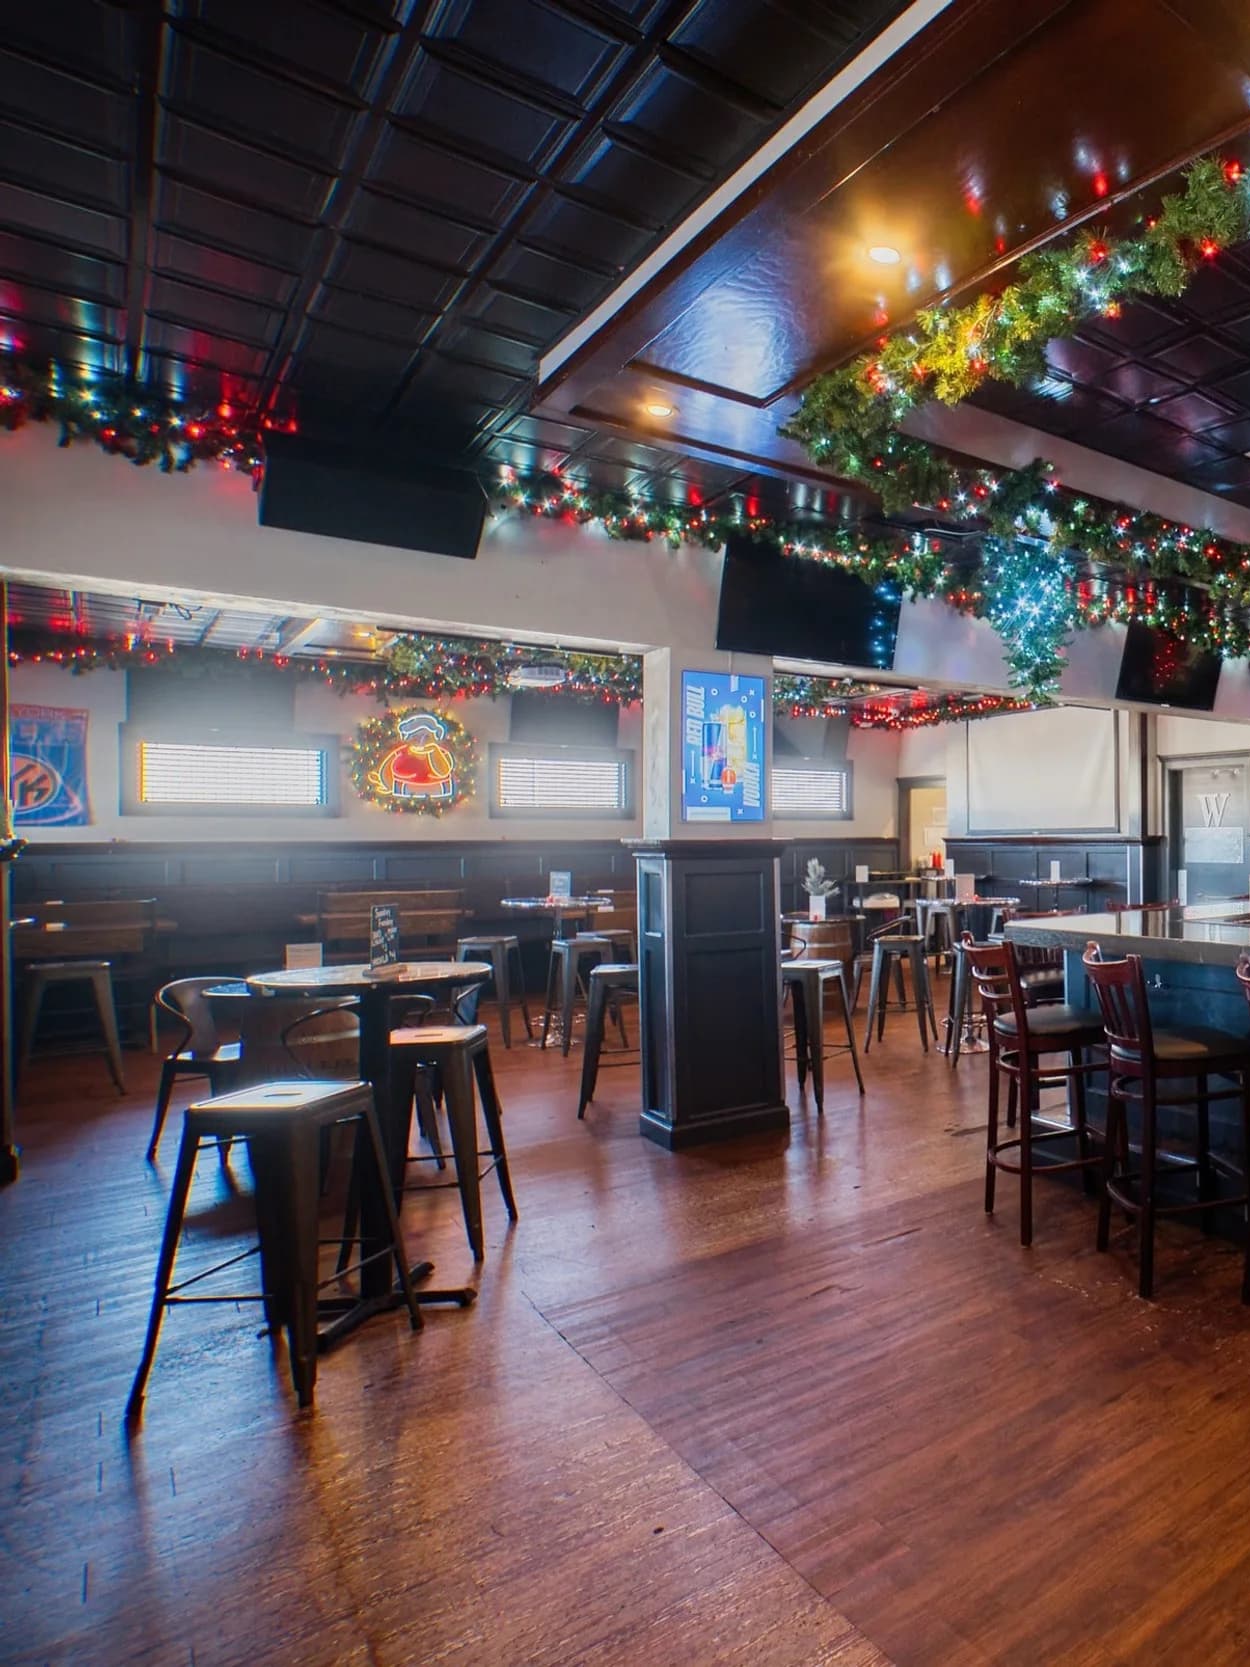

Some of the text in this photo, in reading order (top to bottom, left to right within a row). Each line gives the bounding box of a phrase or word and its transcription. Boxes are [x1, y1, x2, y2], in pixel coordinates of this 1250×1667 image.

[686, 684, 705, 746] RED BULL
[743, 761, 761, 808] VODKA
[1197, 792, 1232, 828] W
